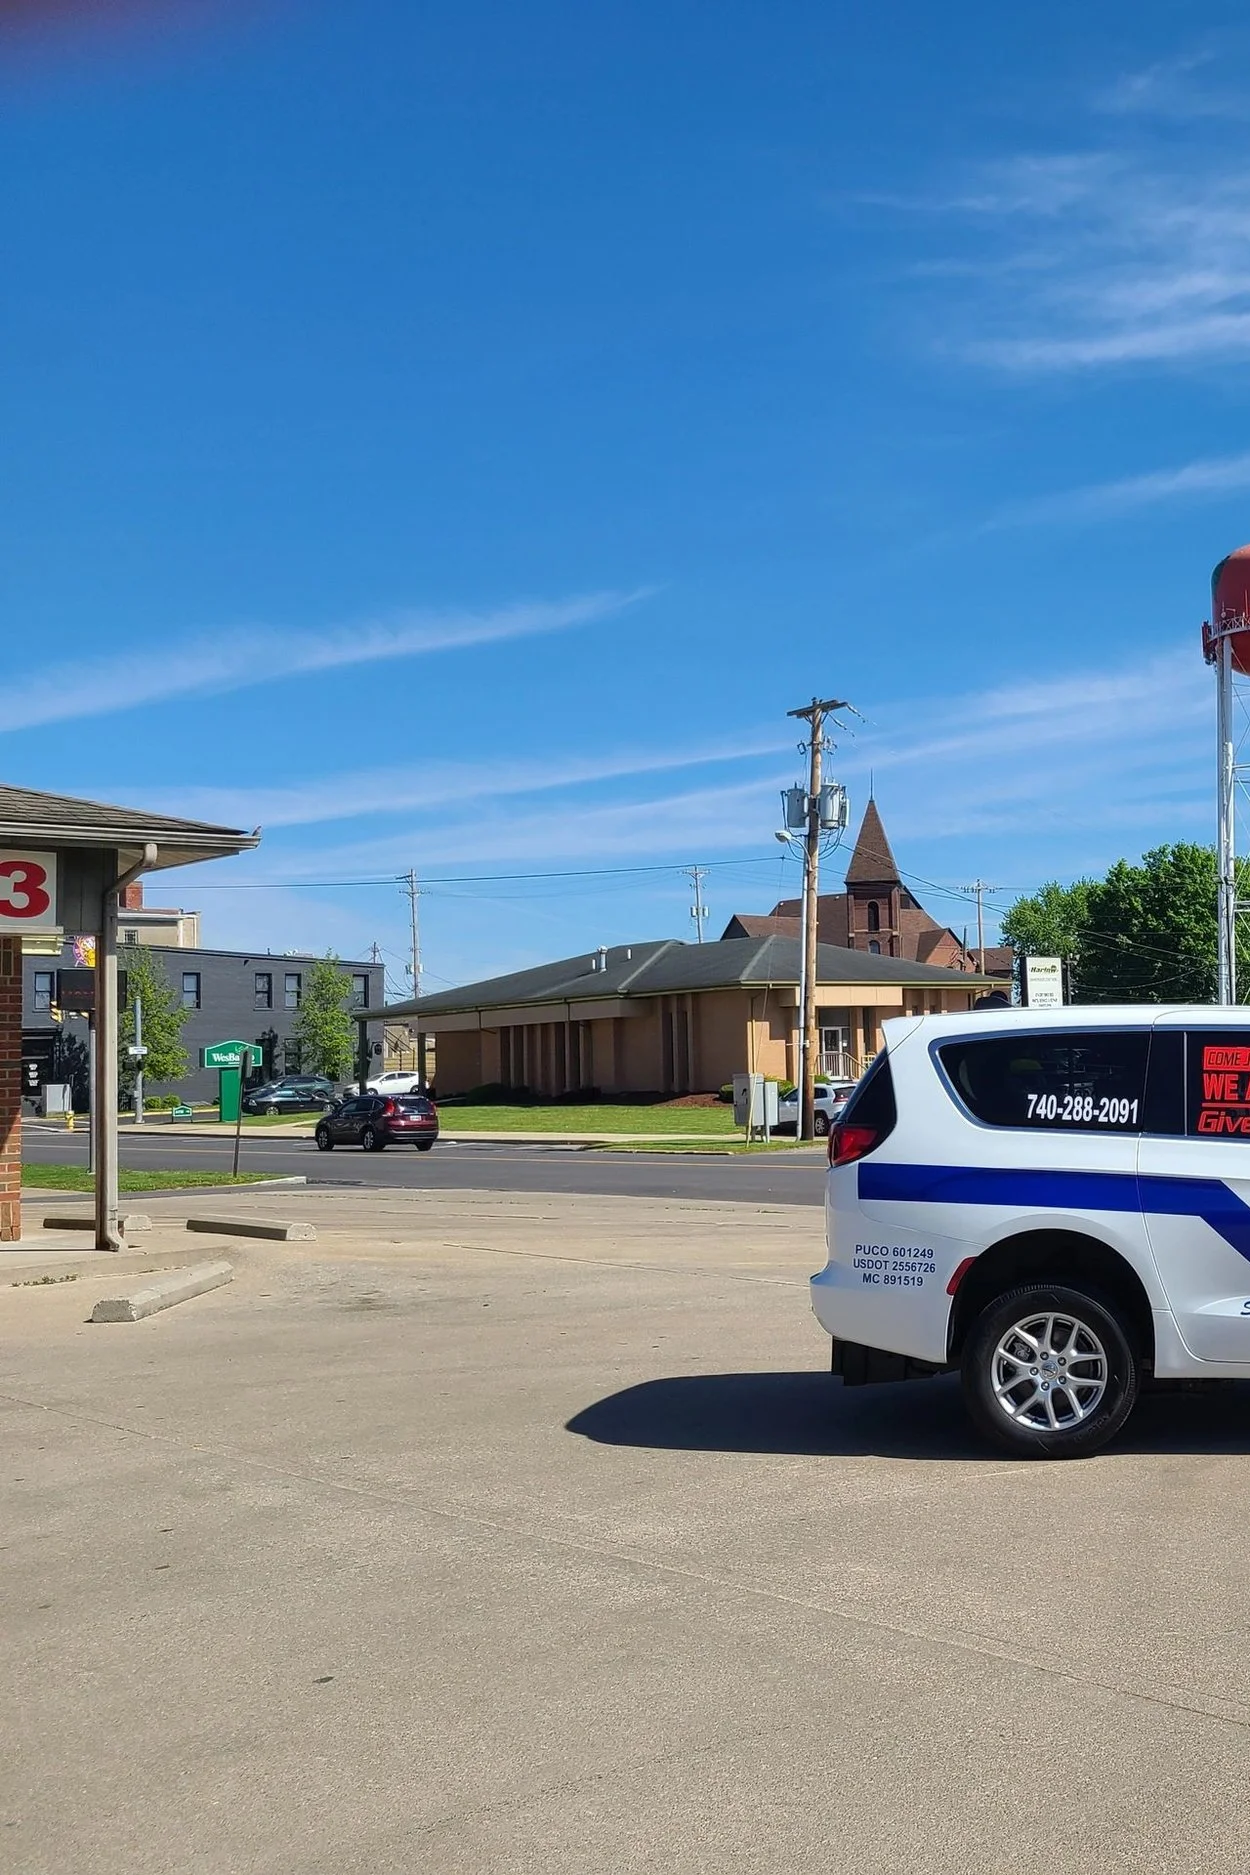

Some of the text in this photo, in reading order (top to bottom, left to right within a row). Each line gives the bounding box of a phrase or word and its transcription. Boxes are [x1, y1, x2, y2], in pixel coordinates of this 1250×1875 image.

[0, 860, 51, 918] 3
[212, 1052, 256, 1062] WesBao
[1207, 1051, 1241, 1066] COME
[1203, 1073, 1239, 1101] WE
[1027, 1093, 1139, 1124] 740-288-2091
[855, 1244, 934, 1259] PUCO 601249
[853, 1258, 936, 1273] USDOT 2556726
[862, 1272, 924, 1287] MC 891519
